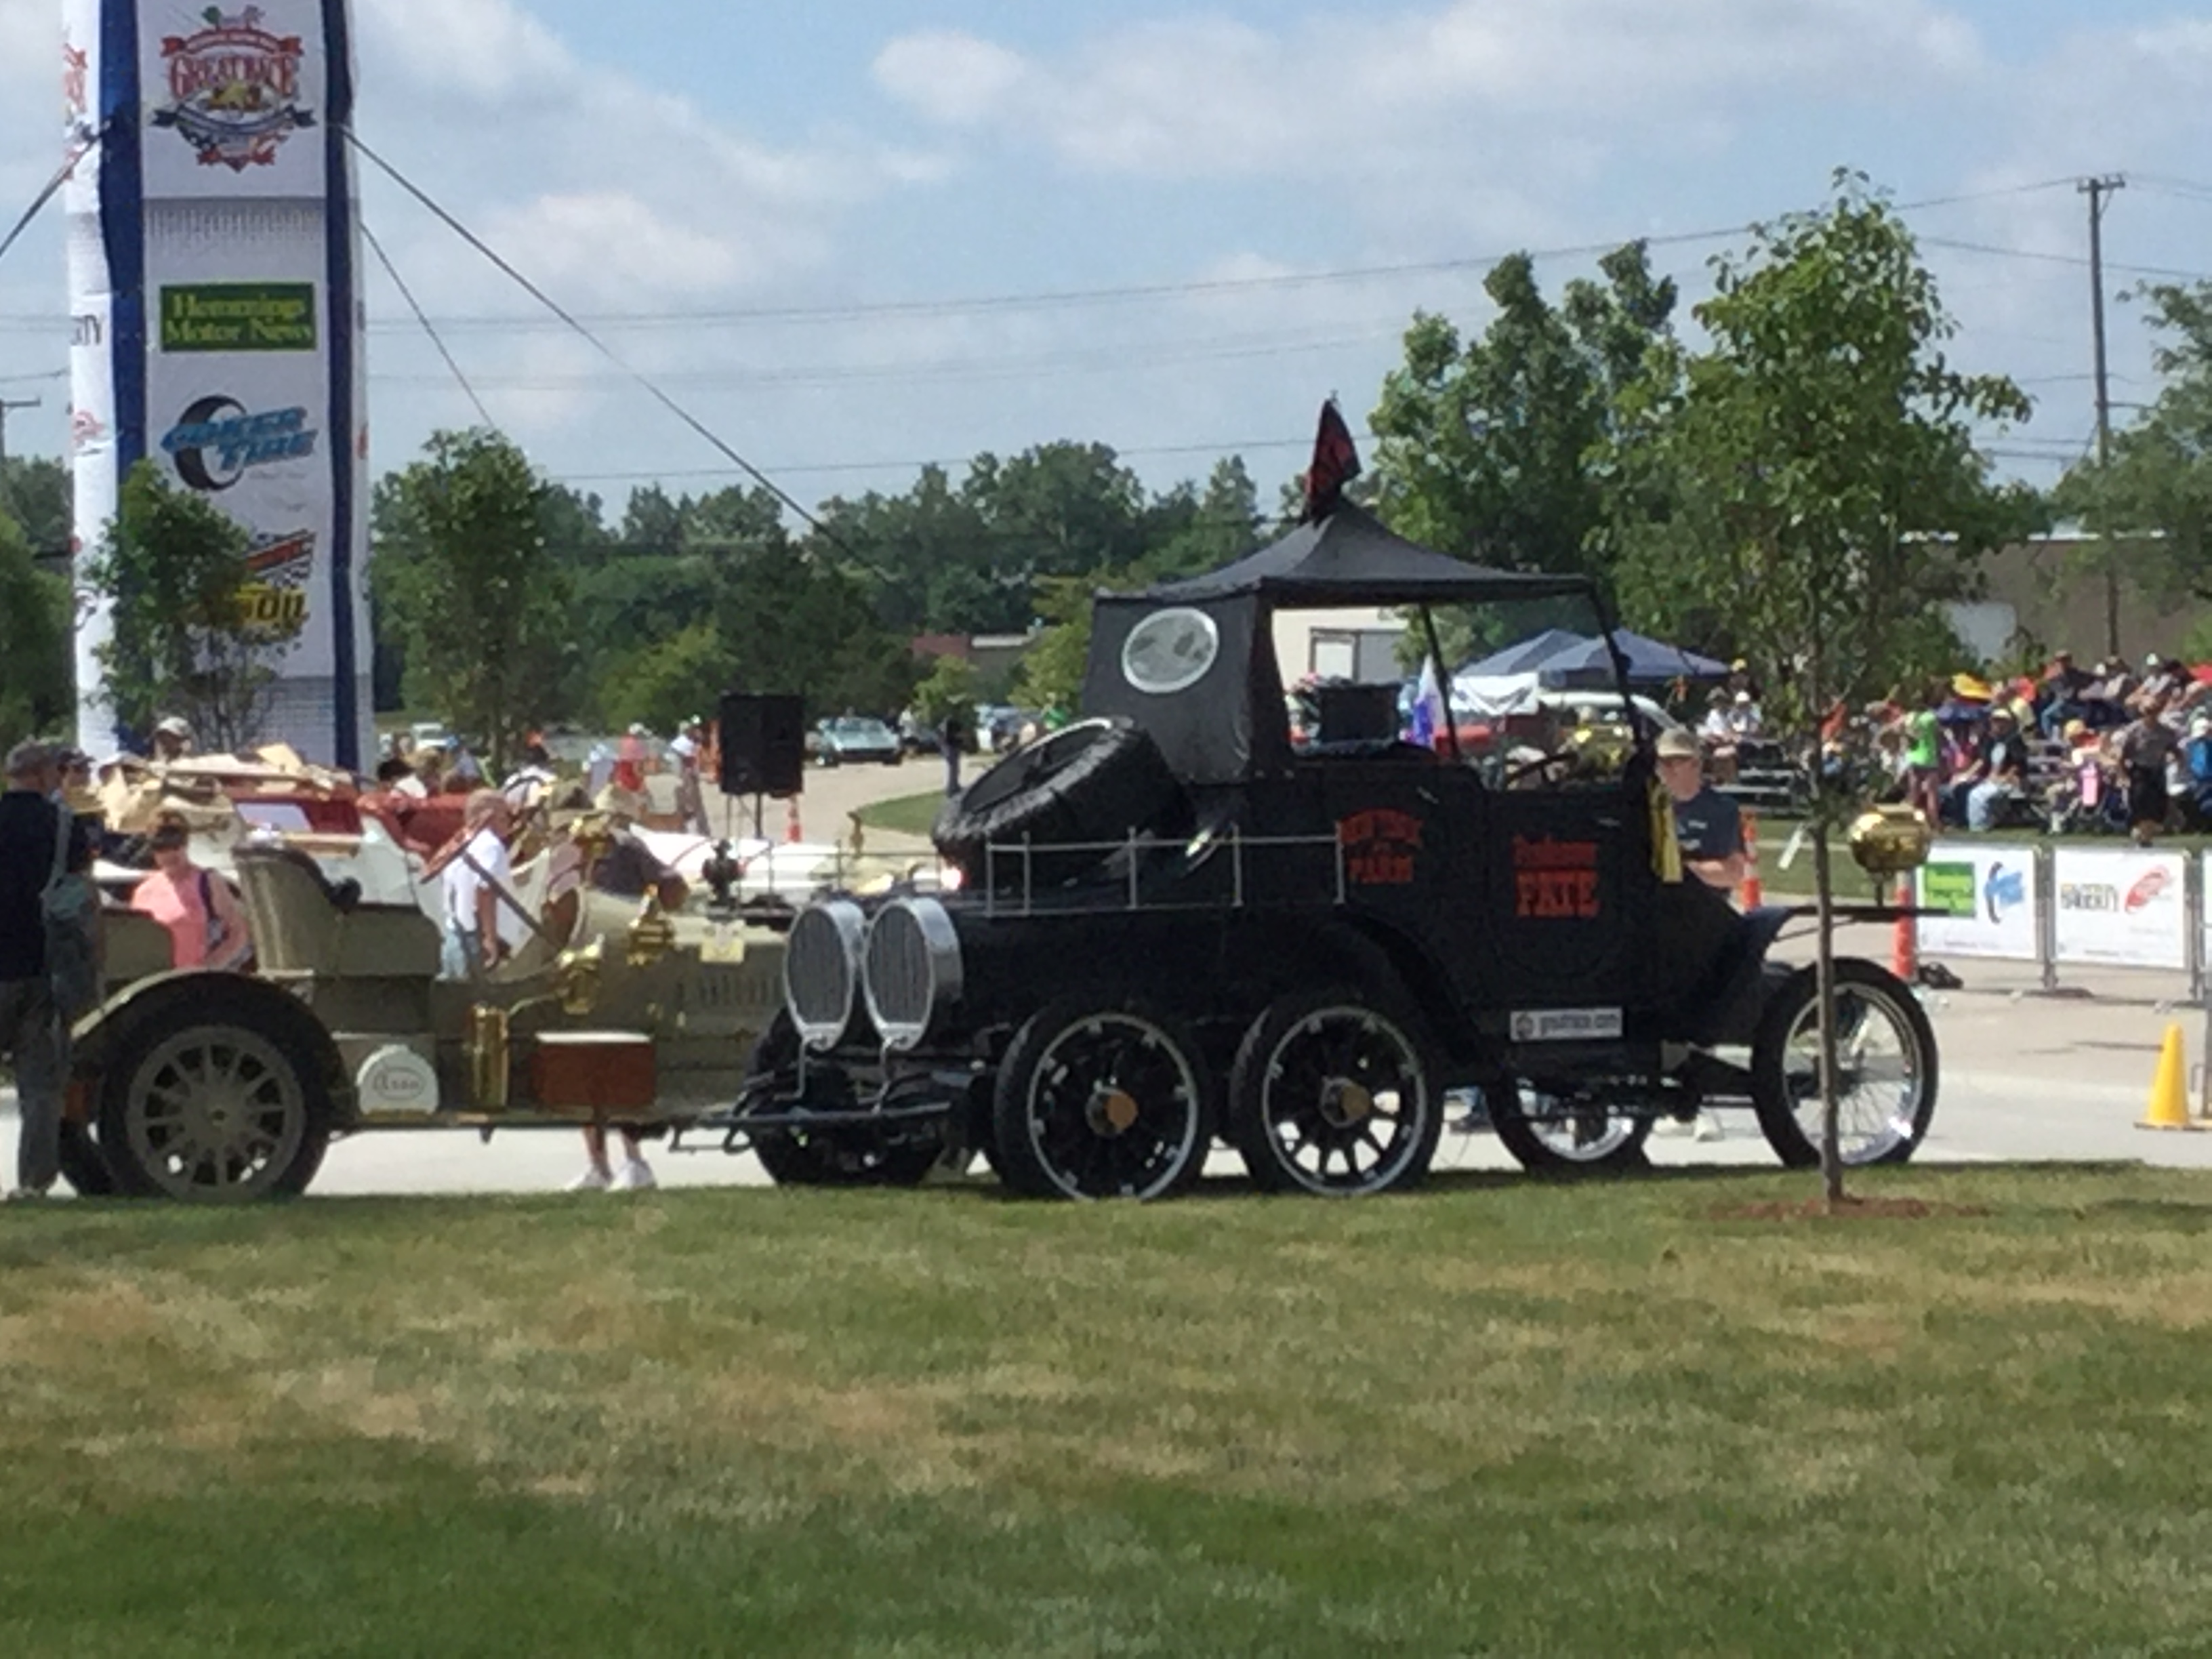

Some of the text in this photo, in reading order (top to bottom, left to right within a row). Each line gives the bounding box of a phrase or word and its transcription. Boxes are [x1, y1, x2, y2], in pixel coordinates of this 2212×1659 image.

[172, 293, 306, 319] Hemmings
[166, 316, 312, 342] Motor News
[1516, 869, 1600, 917] FATE
